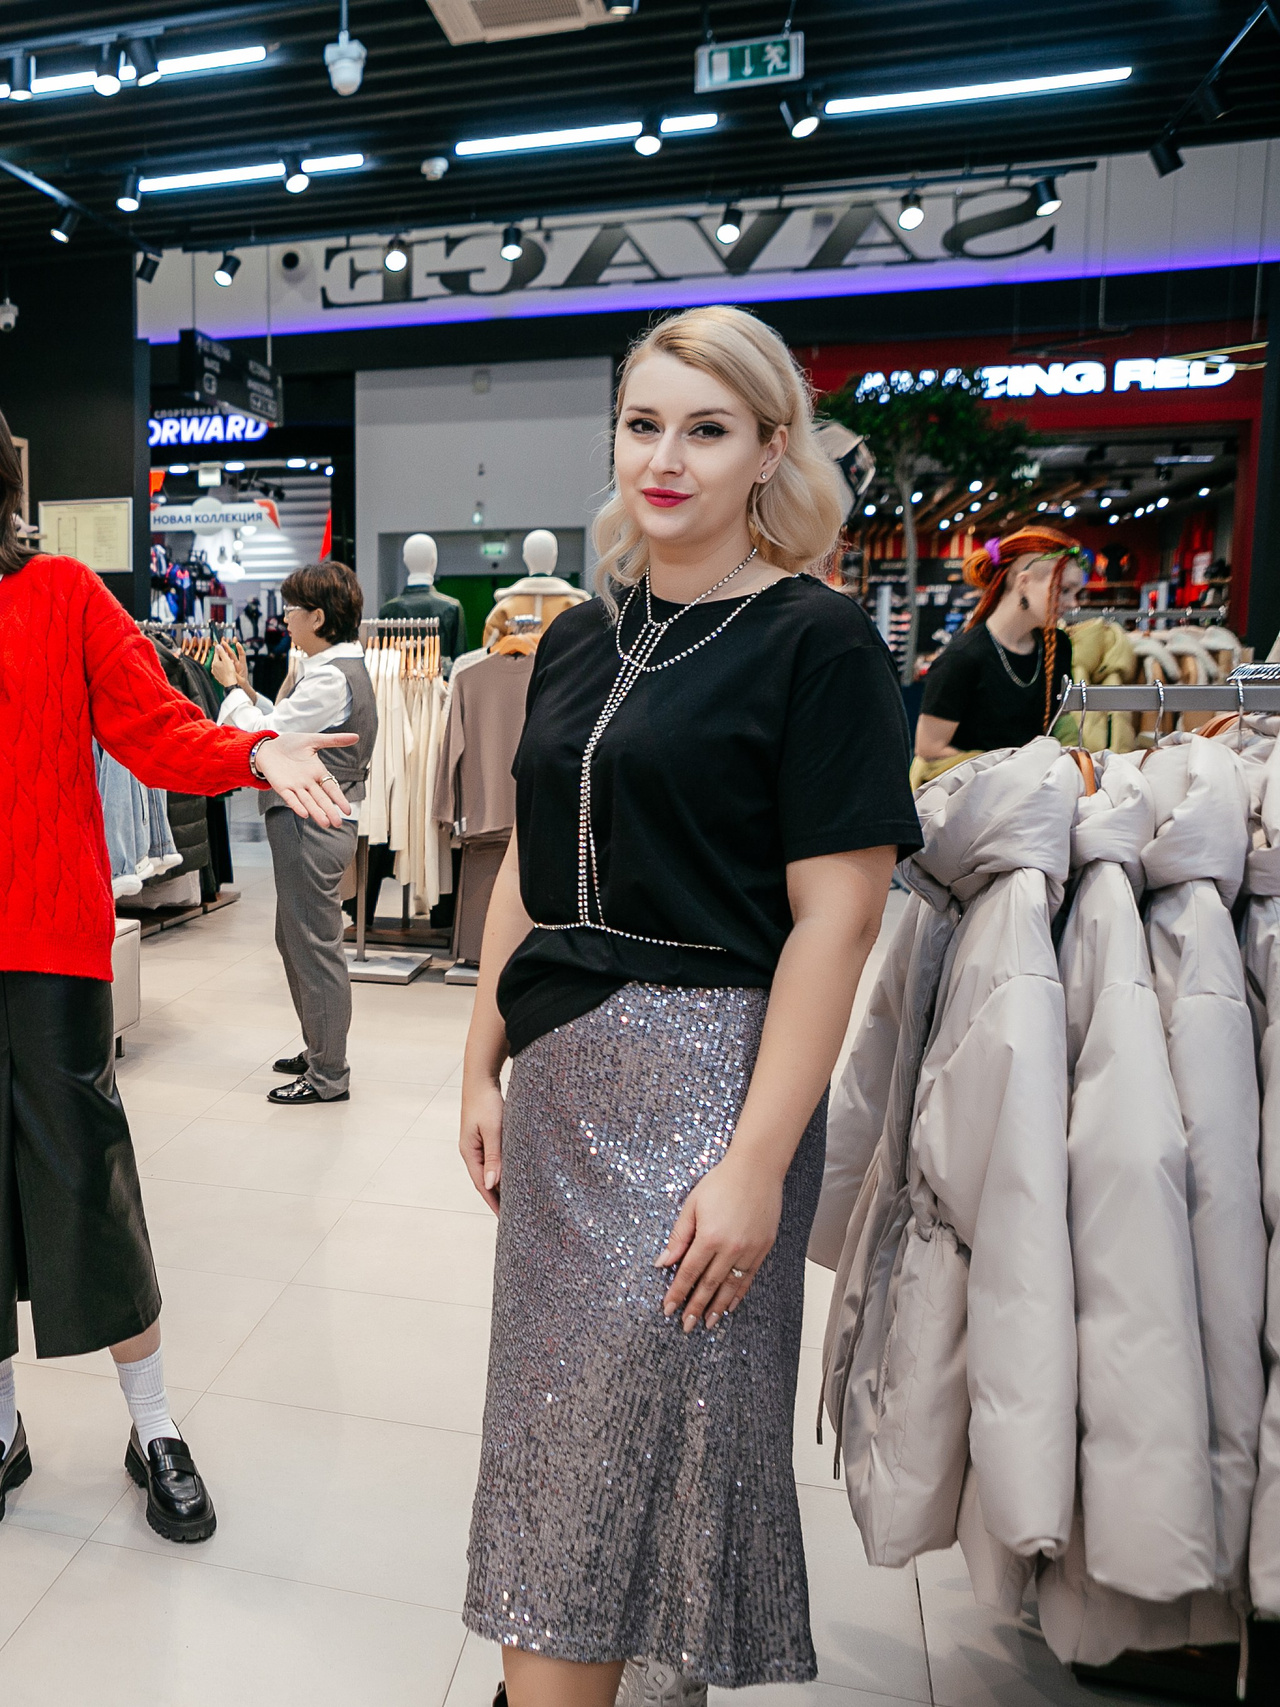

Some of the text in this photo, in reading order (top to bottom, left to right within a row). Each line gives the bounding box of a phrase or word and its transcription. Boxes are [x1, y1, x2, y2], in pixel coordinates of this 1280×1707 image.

[1113, 355, 1236, 392] RED
[153, 512, 263, 525] НОВАЯ КОЛЛЕКЦИЯ
